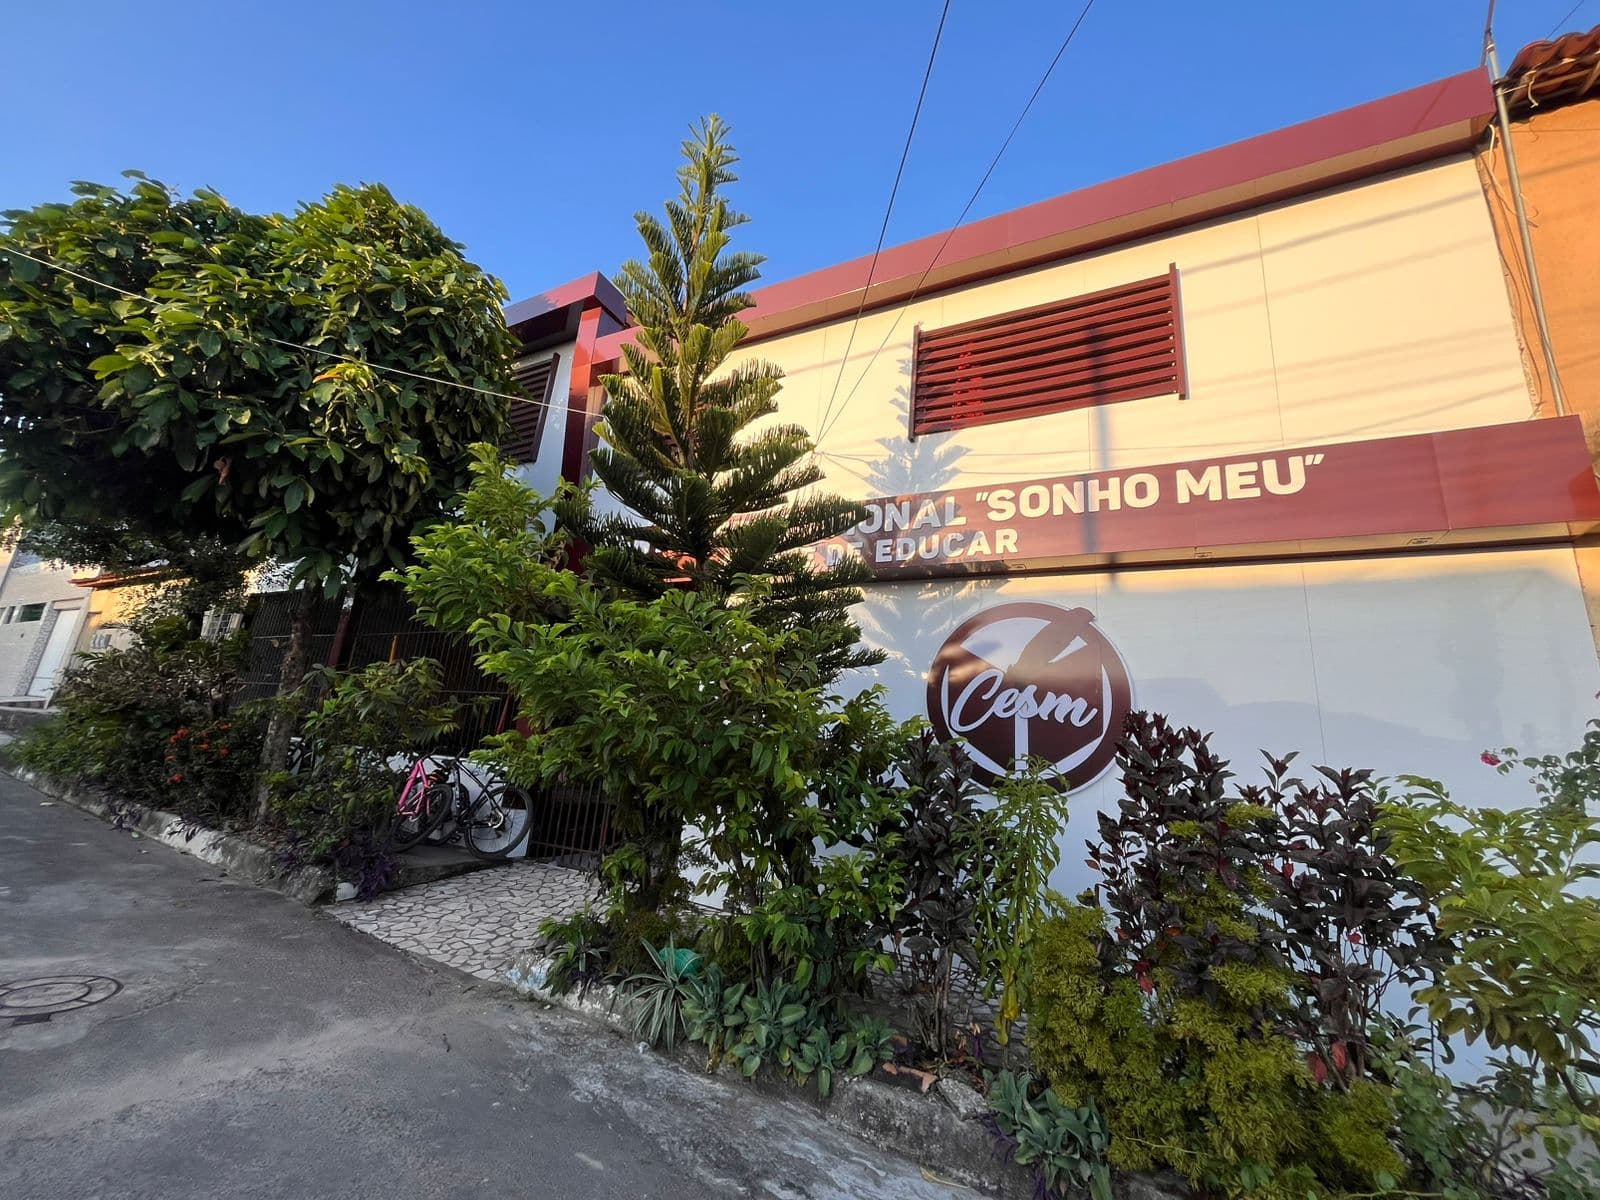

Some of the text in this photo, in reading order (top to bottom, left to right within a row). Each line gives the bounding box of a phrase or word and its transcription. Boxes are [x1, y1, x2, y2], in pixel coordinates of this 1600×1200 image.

[847, 453, 1325, 535] ONAL "SONHO MEU"
[875, 528, 1018, 563] EDUCAR
[950, 668, 1098, 732] Cesm
